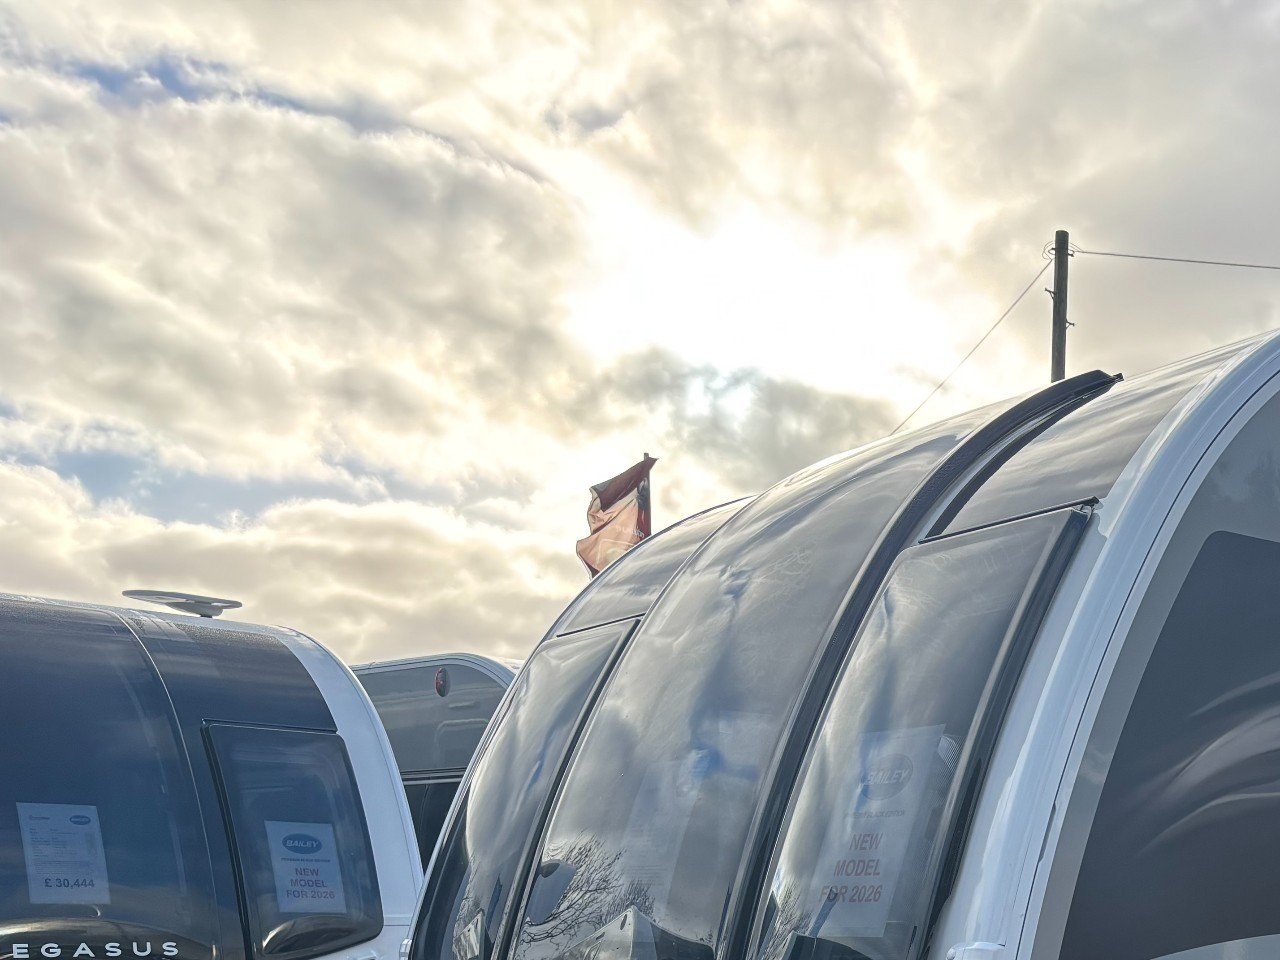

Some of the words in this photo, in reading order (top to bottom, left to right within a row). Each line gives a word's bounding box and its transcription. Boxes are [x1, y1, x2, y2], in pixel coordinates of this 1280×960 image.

[286, 839, 319, 848] BAILEY
[849, 832, 883, 850] NEW
[295, 867, 319, 877] NEW
[833, 859, 881, 877] MODEL
[290, 879, 328, 888] MODEL
[286, 889, 309, 899] FOR
[311, 890, 336, 900] 2026
[849, 885, 883, 903] 2026
[12, 942, 179, 959] EGASUS
